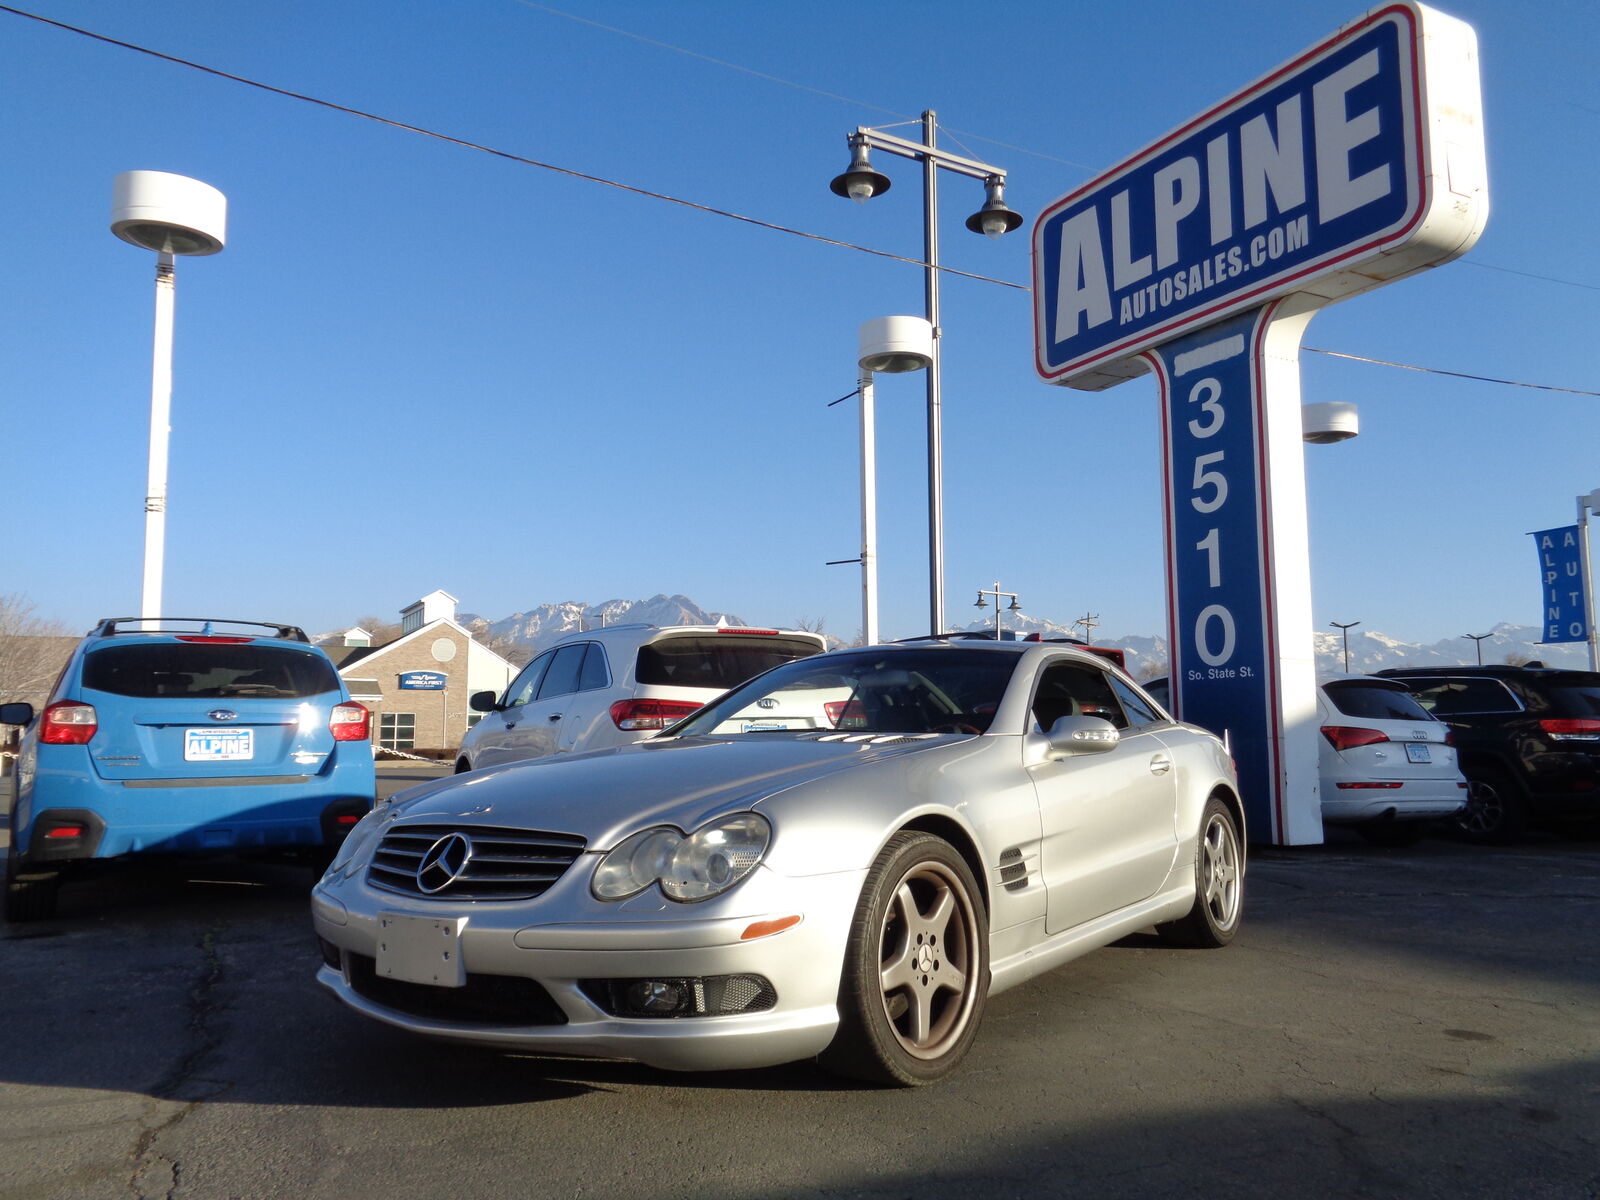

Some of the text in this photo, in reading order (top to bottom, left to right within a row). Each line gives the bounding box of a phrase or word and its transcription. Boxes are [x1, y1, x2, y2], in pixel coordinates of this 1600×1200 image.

[1055, 47, 1392, 343] ALPINE
[1120, 216, 1310, 325] AUTOSALES.COM
[1187, 378, 1236, 667] 3510
[1542, 535, 1560, 638] ALPINE
[1564, 532, 1583, 637] AUTO
[1188, 666, 1254, 680] So. State St.
[189, 740, 249, 754] ALPINE
